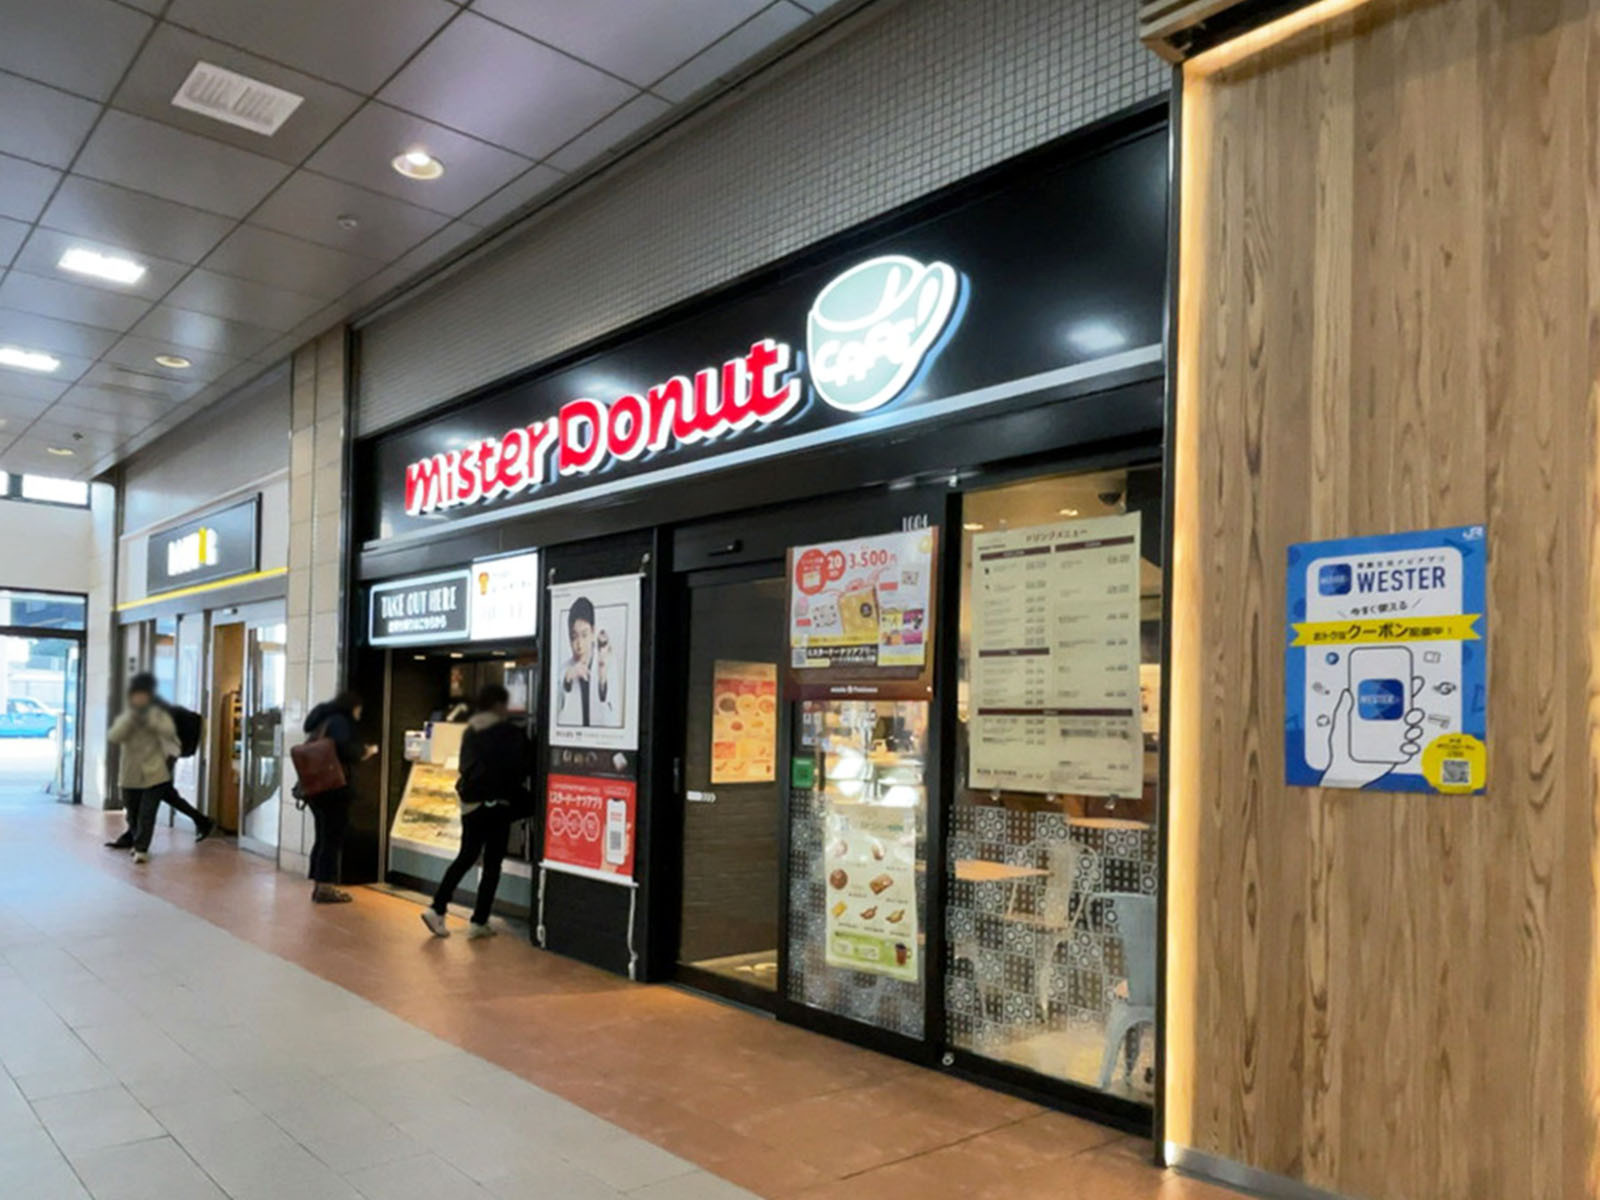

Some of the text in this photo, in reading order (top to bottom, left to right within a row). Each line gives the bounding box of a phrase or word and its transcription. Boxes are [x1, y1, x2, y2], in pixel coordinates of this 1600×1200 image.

[558, 338, 802, 475] Donut
[1357, 566, 1446, 593] WESTER
[381, 586, 457, 619] TAKE OUT HERE
